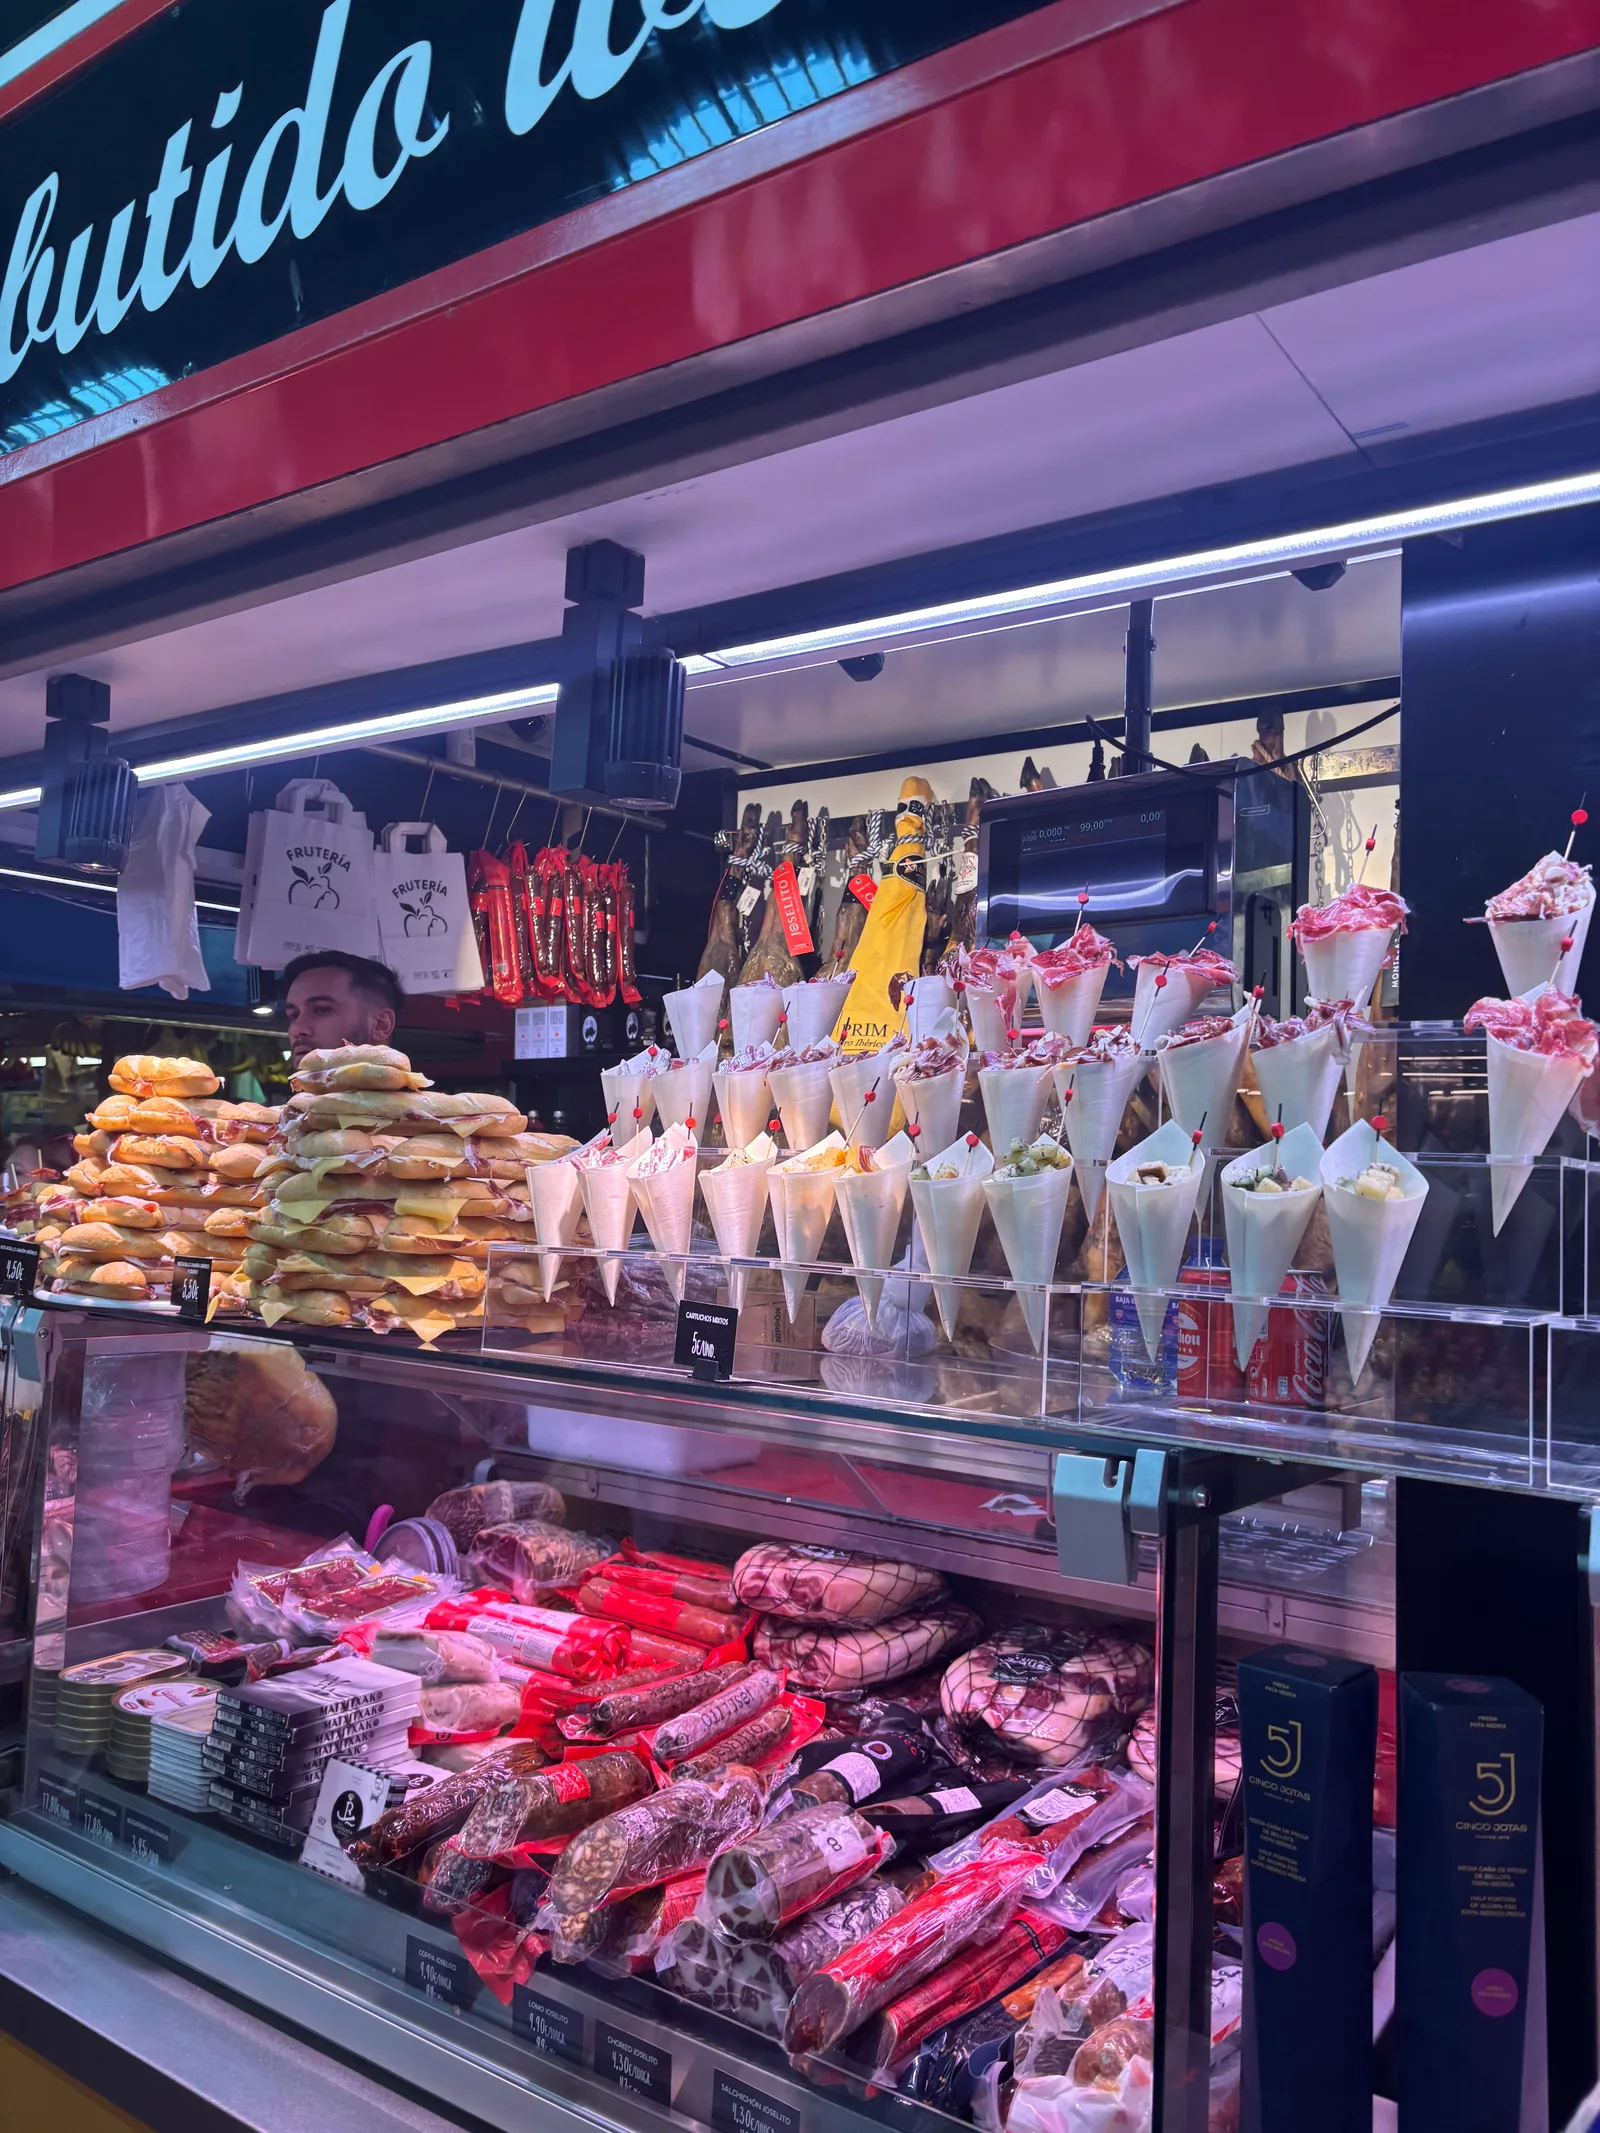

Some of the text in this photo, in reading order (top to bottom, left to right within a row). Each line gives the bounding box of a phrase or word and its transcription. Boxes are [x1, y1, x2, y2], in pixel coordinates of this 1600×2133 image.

[1080, 820, 1104, 833] 99,00
[1140, 811, 1161, 823] 0,00
[285, 846, 352, 872] FRUTERÍA
[391, 879, 449, 899] FRUTERÍA
[778, 879, 803, 937] JOSELITO
[1115, 1296, 1130, 1304] BAJA
[685, 1311, 729, 1326] CARTUCHOS MIXTOS
[1178, 1329, 1200, 1346] hou
[1260, 1720, 1302, 1778] 5J
[1249, 1775, 1278, 1792] CINCO
[1280, 1785, 1311, 1802] JOTAS
[1469, 1753, 1516, 1816] 5J
[1456, 1821, 1528, 1833] CINCO JOTAS
[418, 1949, 435, 1962] COPPA
[528, 2000, 569, 2024] LOMO JOSELITO
[607, 2036, 659, 2066] CHORIZO JOSELITO
[721, 2083, 791, 2126] SALCHICHÓN JOSELITO
